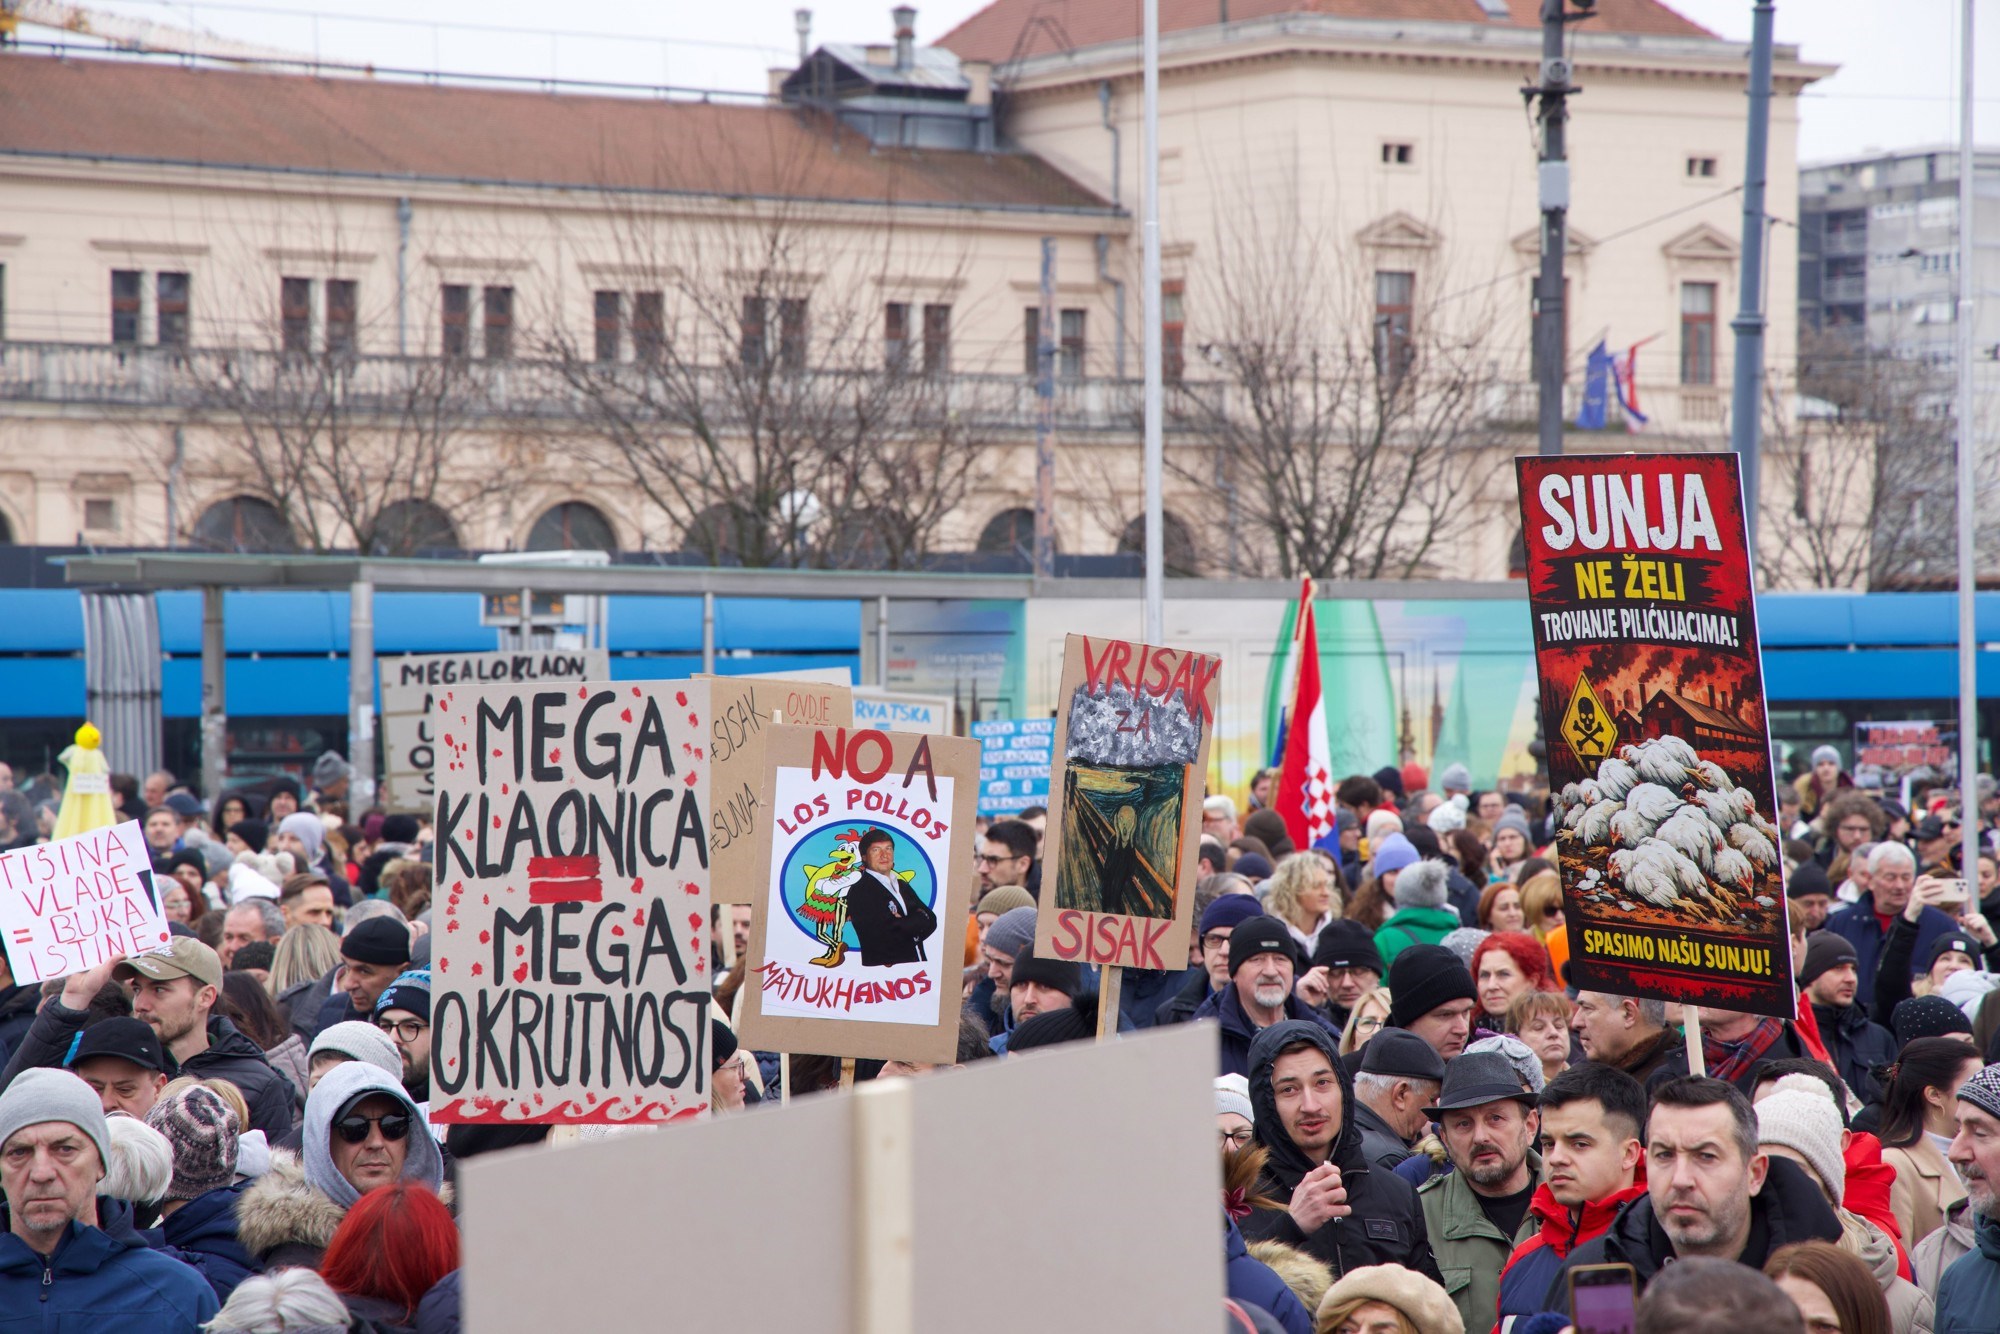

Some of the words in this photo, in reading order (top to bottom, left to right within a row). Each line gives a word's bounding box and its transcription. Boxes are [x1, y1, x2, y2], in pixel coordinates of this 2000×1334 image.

[1538, 473, 1722, 551] SUNJA
[1574, 561, 1616, 600] NE
[1621, 553, 1686, 601] ŽELI
[1540, 608, 1619, 642] TROVANJE
[1620, 602, 1740, 647] PILIĆNJACIMA!
[787, 692, 831, 721] OVDJE
[1083, 635, 1222, 725] VRISAK
[476, 690, 675, 787] MEGA
[855, 699, 931, 723] RVATSKA
[1115, 708, 1150, 743] ZA
[811, 727, 894, 785] NO
[902, 734, 938, 802] A
[435, 788, 709, 886] KLAONICA
[776, 793, 830, 836] LOS
[846, 788, 949, 840] POLLOS
[0, 830, 129, 890] TIŠINA
[21, 863, 134, 917] VLADE
[50, 896, 146, 944] BUKA
[493, 897, 688, 989] MEGA
[1051, 909, 1172, 971] SISAK
[29, 922, 156, 981] ISTINE
[1584, 929, 1655, 961] SPASIMO
[1658, 934, 1701, 967] NAŠU
[1705, 944, 1772, 976] SUNJU!
[431, 988, 711, 1095] OKRUTNOST
